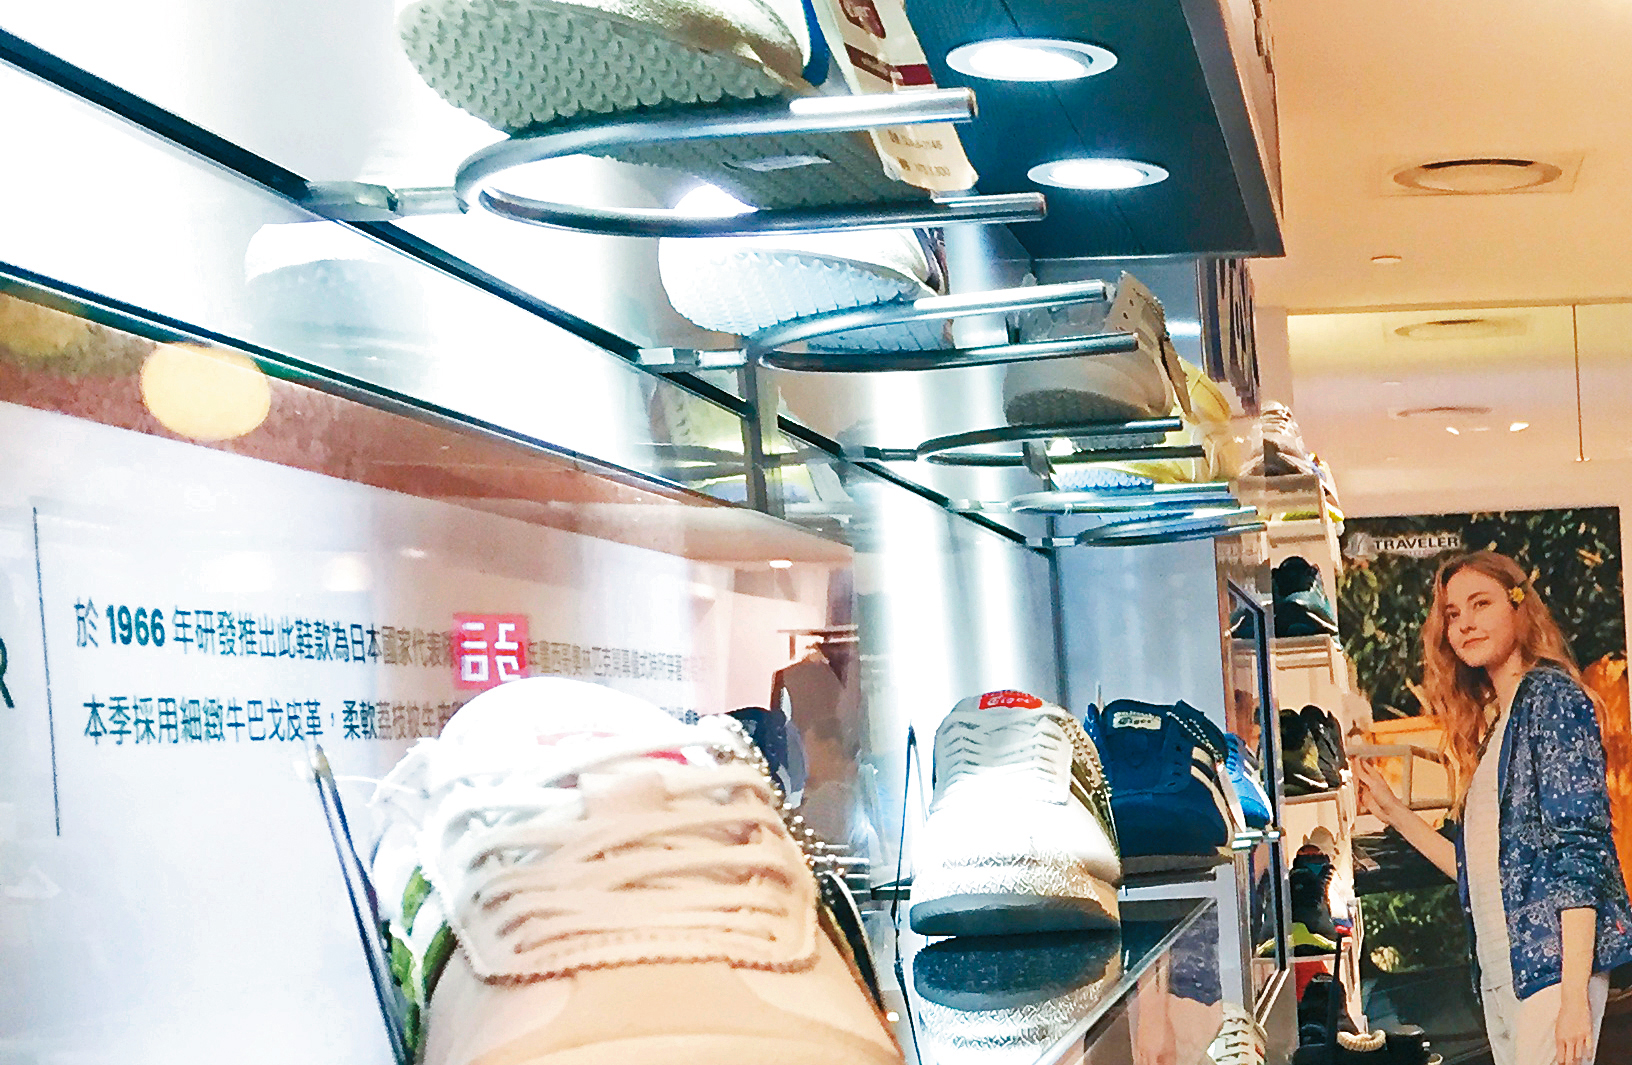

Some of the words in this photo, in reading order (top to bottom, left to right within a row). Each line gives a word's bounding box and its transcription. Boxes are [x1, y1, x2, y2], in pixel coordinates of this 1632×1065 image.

[1375, 536, 1459, 551] TRAVELER
[74, 596, 99, 648] 於
[106, 603, 166, 648] 1966
